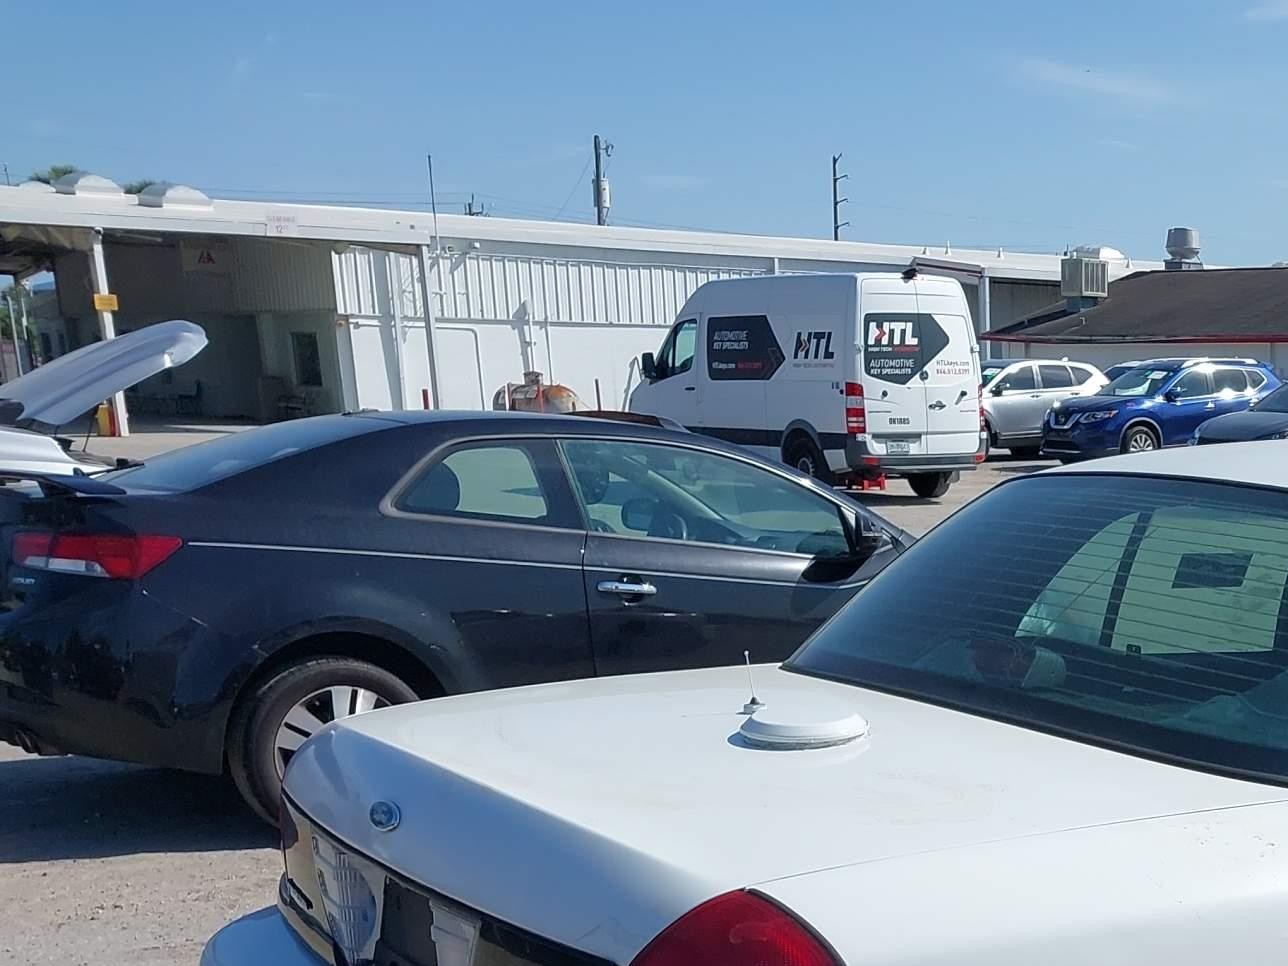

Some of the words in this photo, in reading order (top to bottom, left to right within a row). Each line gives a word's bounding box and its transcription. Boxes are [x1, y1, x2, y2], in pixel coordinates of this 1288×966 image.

[793, 331, 835, 359] HTL
[868, 321, 919, 345] HTL
[870, 359, 915, 368] AUTOMOTIVE
